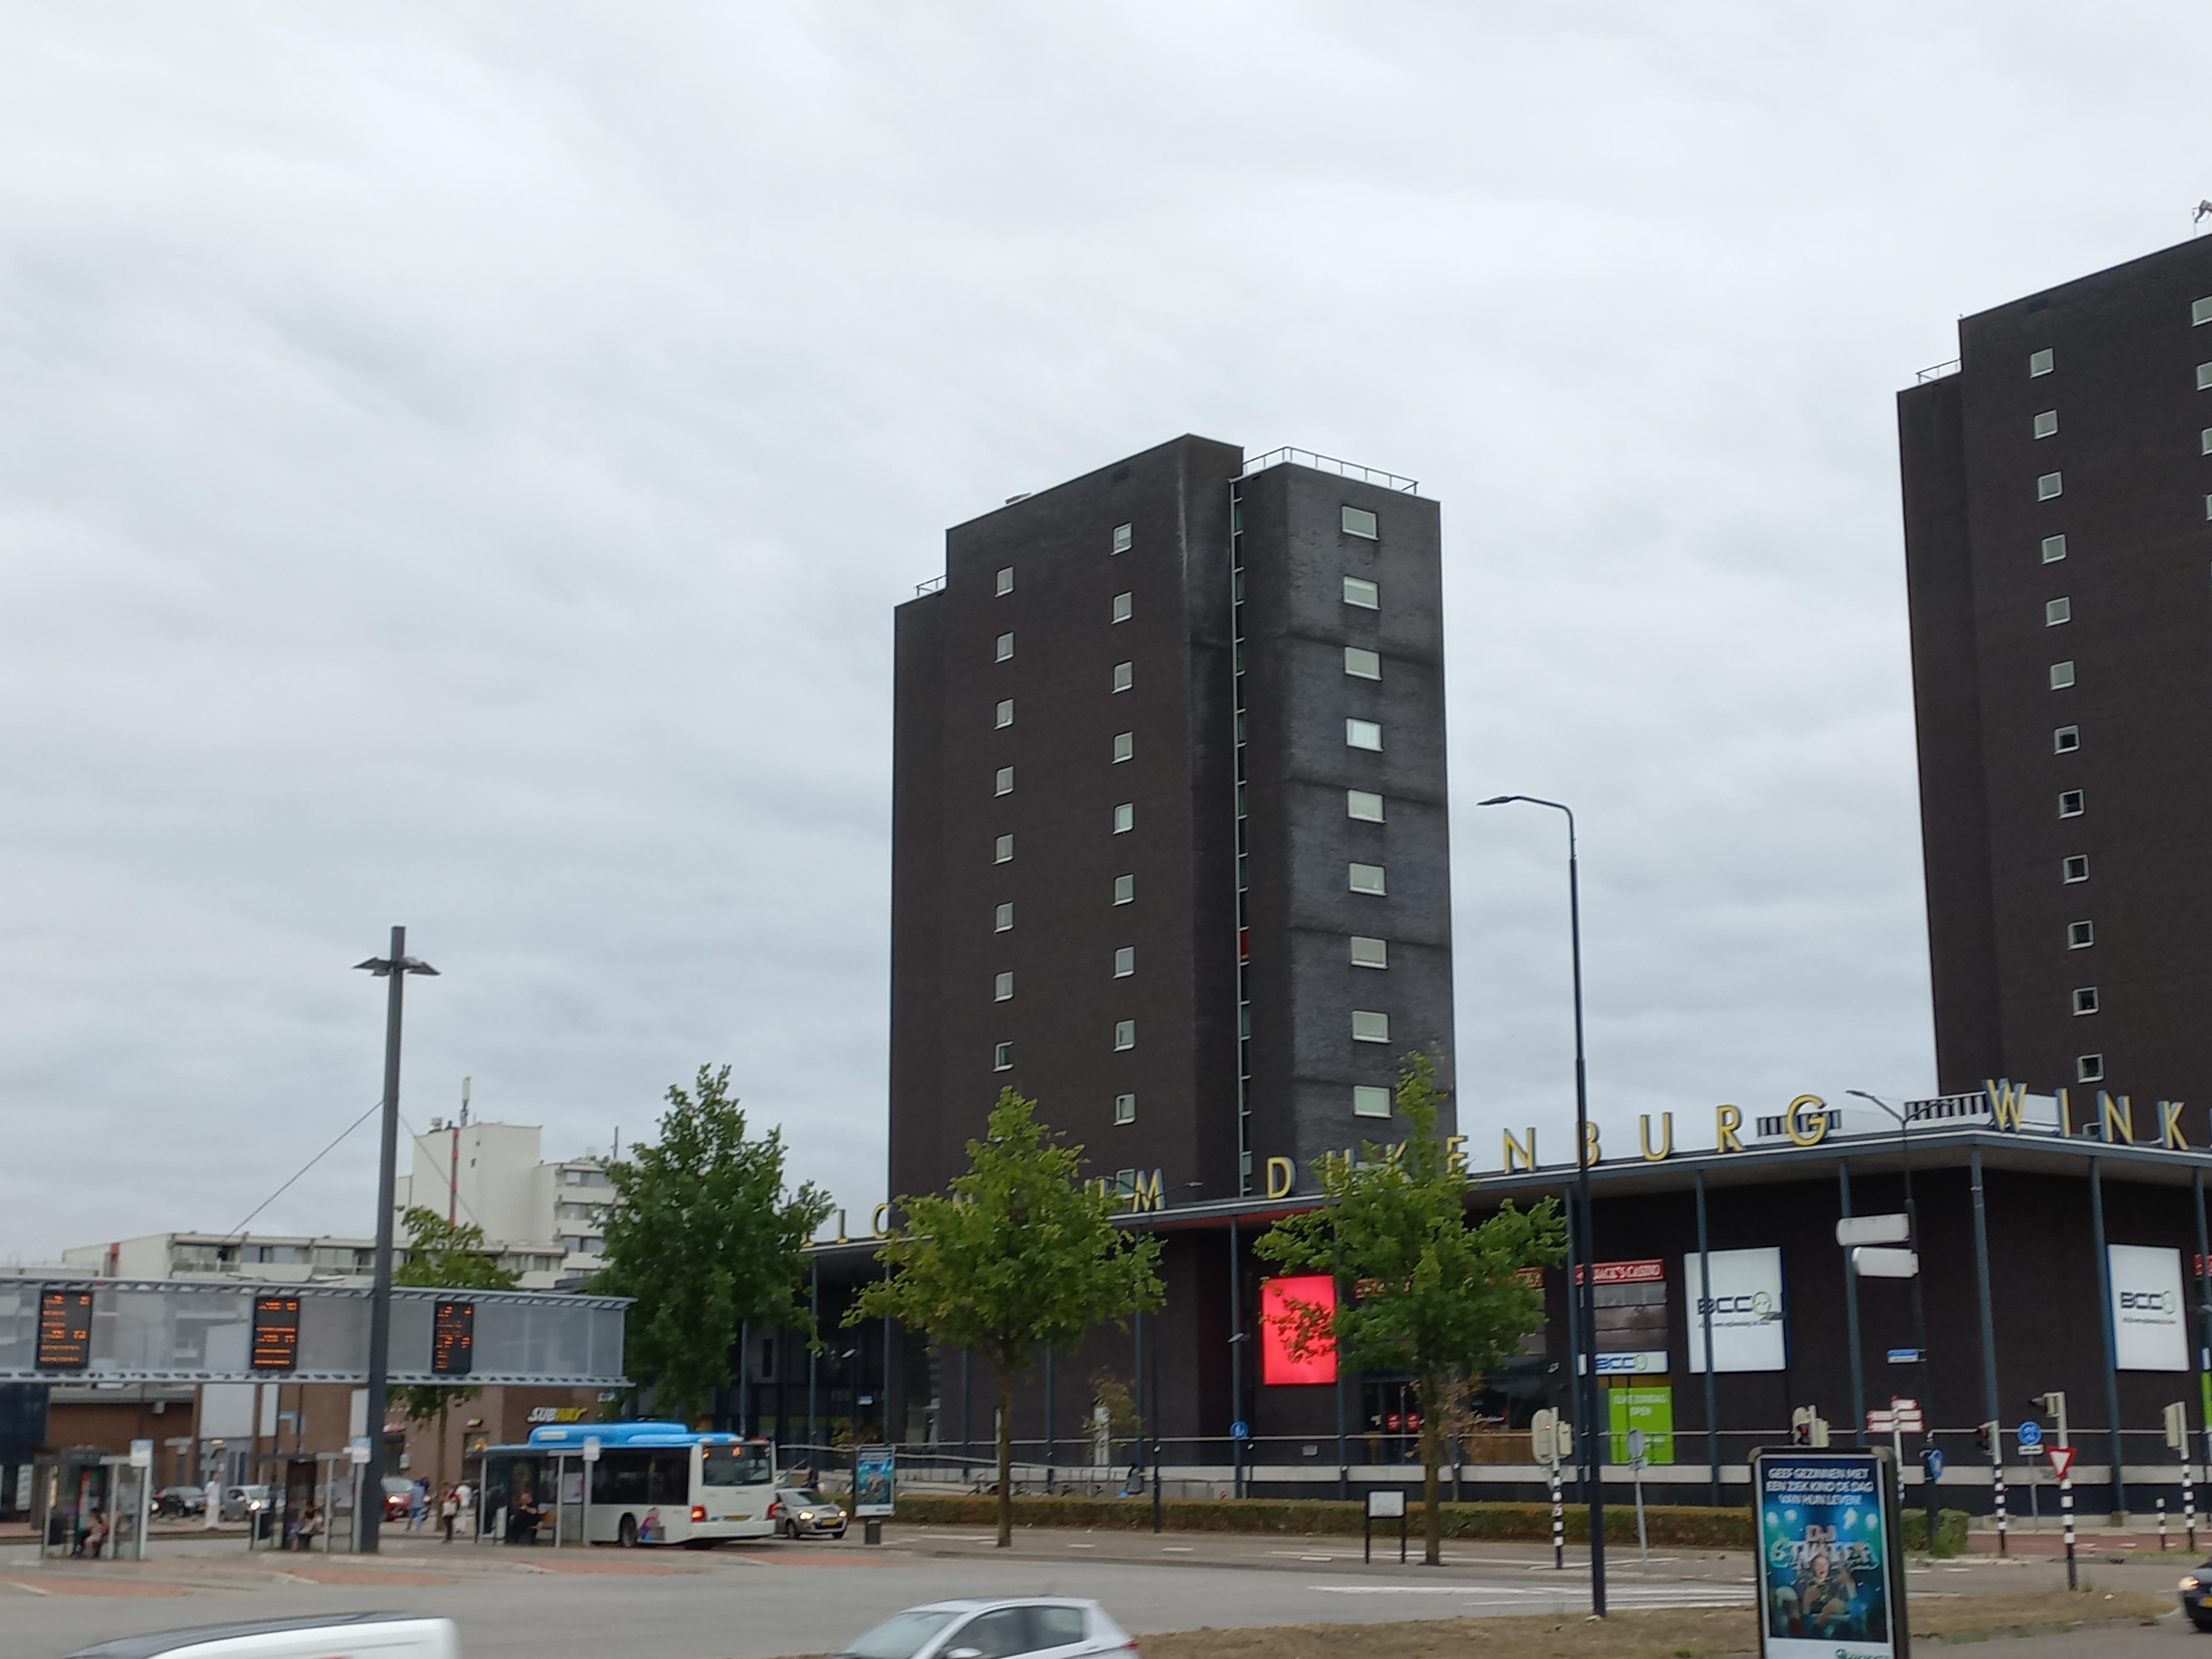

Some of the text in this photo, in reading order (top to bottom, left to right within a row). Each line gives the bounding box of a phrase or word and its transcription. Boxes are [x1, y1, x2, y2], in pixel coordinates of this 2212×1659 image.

[1981, 1077, 2212, 1150] WINK
[1698, 1295, 1754, 1315] BCC
[2121, 1292, 2163, 1310] BCC
[1596, 1357, 1636, 1369] BCC
[1846, 1468, 1870, 1479] MET
